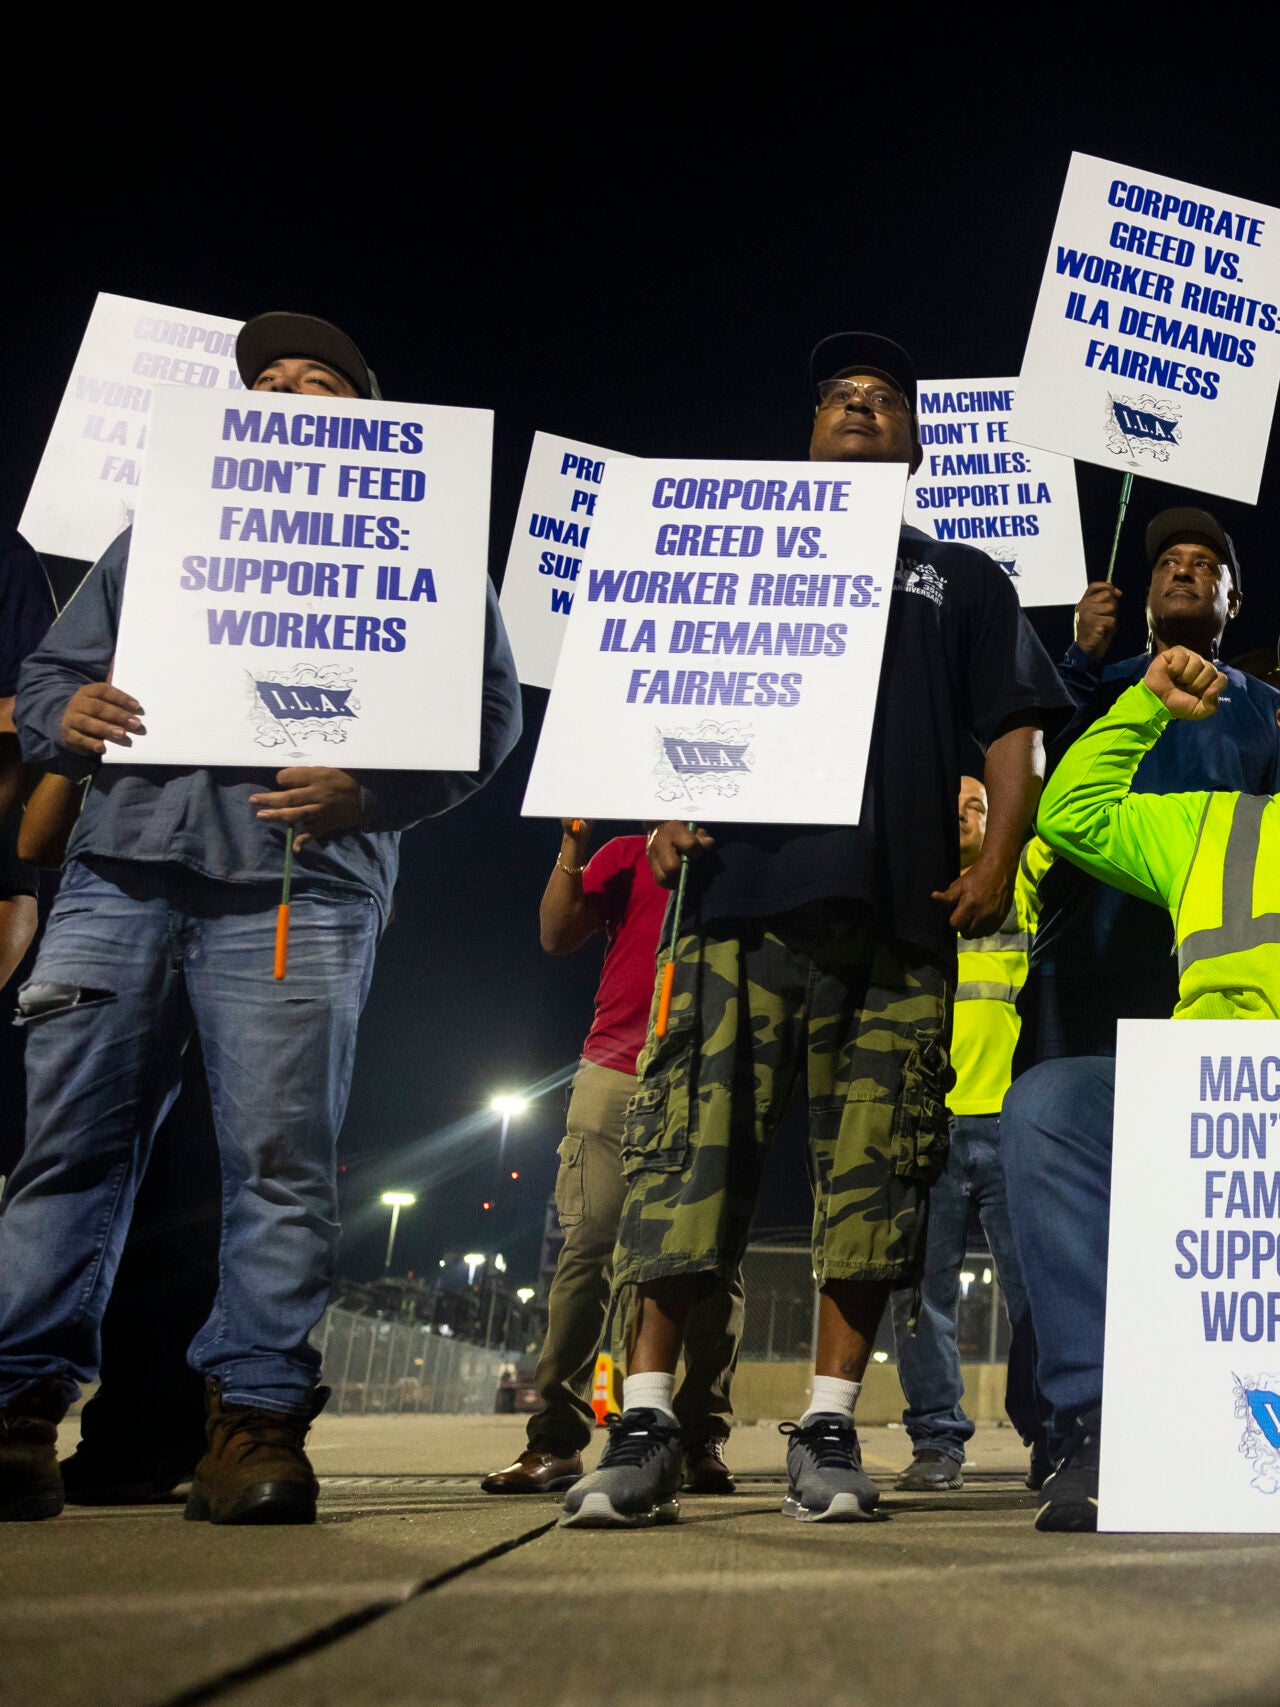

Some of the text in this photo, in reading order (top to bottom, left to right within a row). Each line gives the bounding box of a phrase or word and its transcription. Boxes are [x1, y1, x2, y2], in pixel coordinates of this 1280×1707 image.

[1107, 180, 1265, 247] CORPORATE
[1109, 221, 1243, 282] GREED VS.
[1055, 246, 1174, 304] WORKER
[134, 316, 236, 358] CORPOR
[1064, 292, 1256, 368] ILA DEMANDS
[132, 352, 219, 388] GREED
[1085, 339, 1220, 400] FAIRNESS
[920, 391, 1015, 414] MACHINE
[222, 409, 424, 454] MACHINES
[920, 422, 1009, 445] DON'T FE
[1124, 410, 1171, 440] I.L.A.
[211, 457, 426, 503] DON'T FEED
[560, 453, 605, 484] PRO
[930, 452, 1031, 476] FAMILIES:
[652, 478, 851, 512] CORPORATE
[916, 482, 1051, 509] SUPPORT ILA
[219, 506, 410, 551] FAMILIES:
[655, 524, 828, 559] GREED VS.
[933, 514, 1039, 540] WORKERS
[180, 555, 438, 602] SUPPORT ILA
[588, 570, 741, 604] WORKER
[748, 574, 882, 608] RIGHTS:
[206, 609, 408, 652] WORKERS
[599, 619, 848, 657] ILA DEMANDS
[273, 690, 347, 713] I.L.A.
[626, 670, 803, 707] FAIRNESS
[676, 744, 742, 767] I.L.A.
